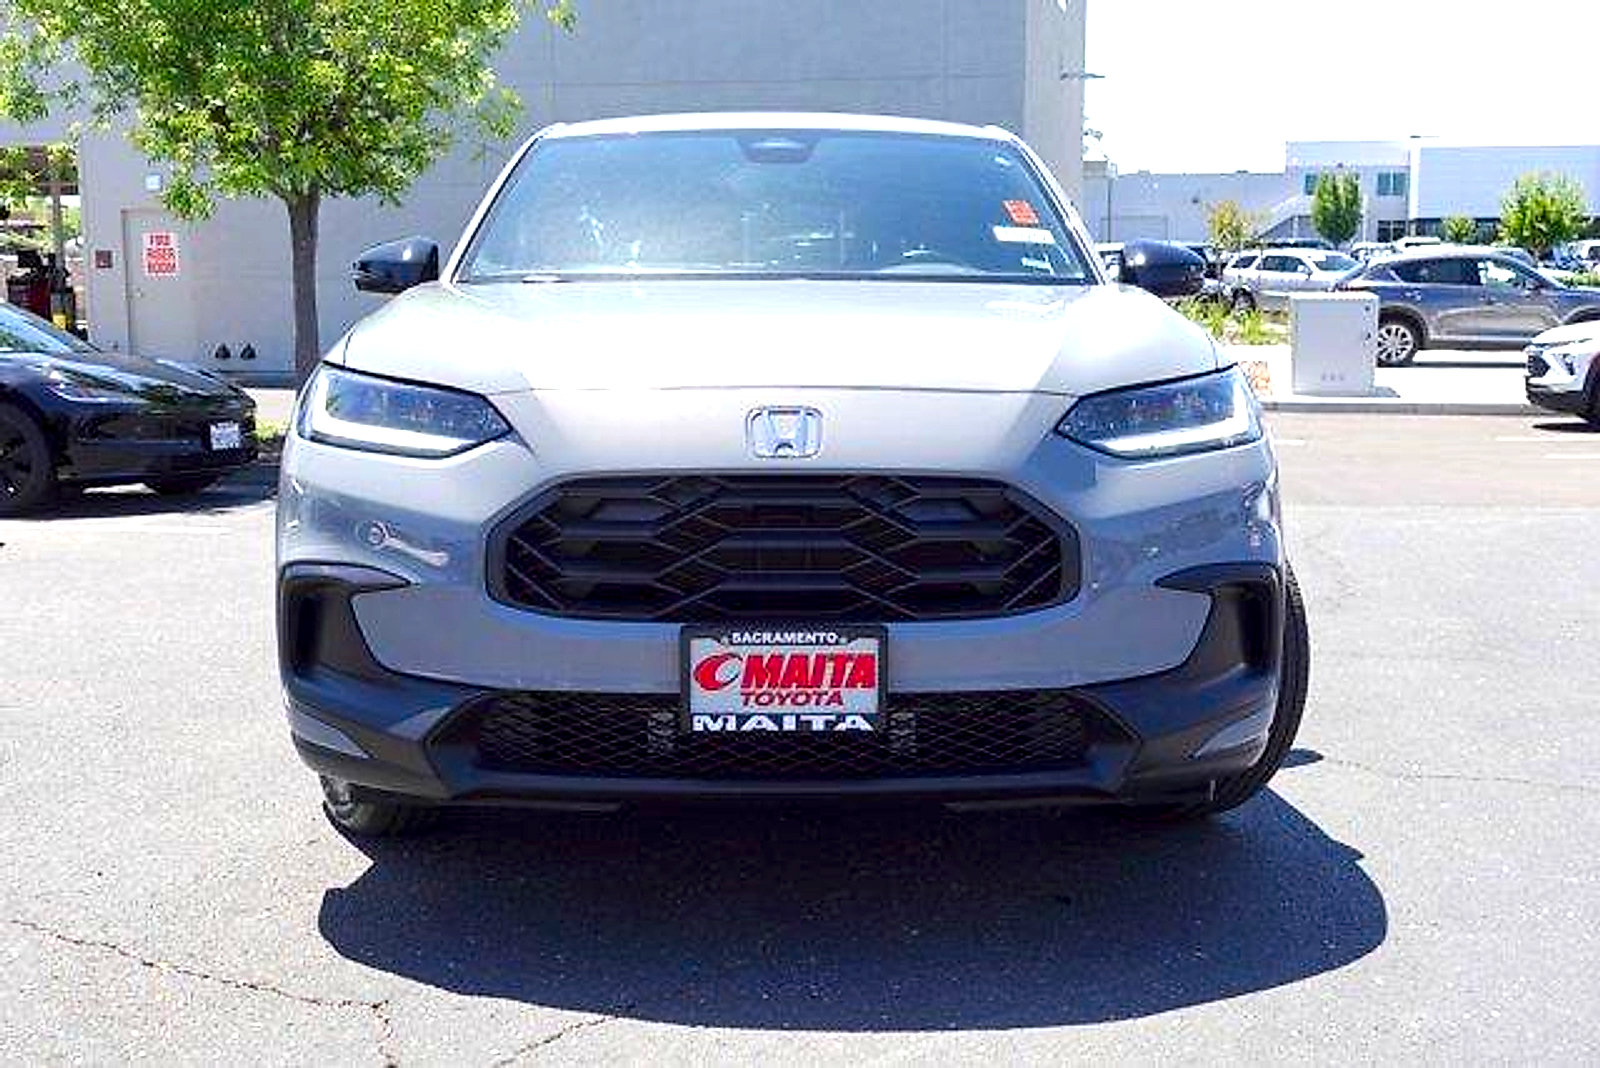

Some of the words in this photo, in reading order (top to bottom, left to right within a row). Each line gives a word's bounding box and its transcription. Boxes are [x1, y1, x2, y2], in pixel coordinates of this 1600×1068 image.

[731, 632, 838, 644] SACRAMENTO
[741, 653, 876, 689] MAITA
[740, 691, 844, 706] TOYOTA
[692, 714, 874, 731] MAITA
